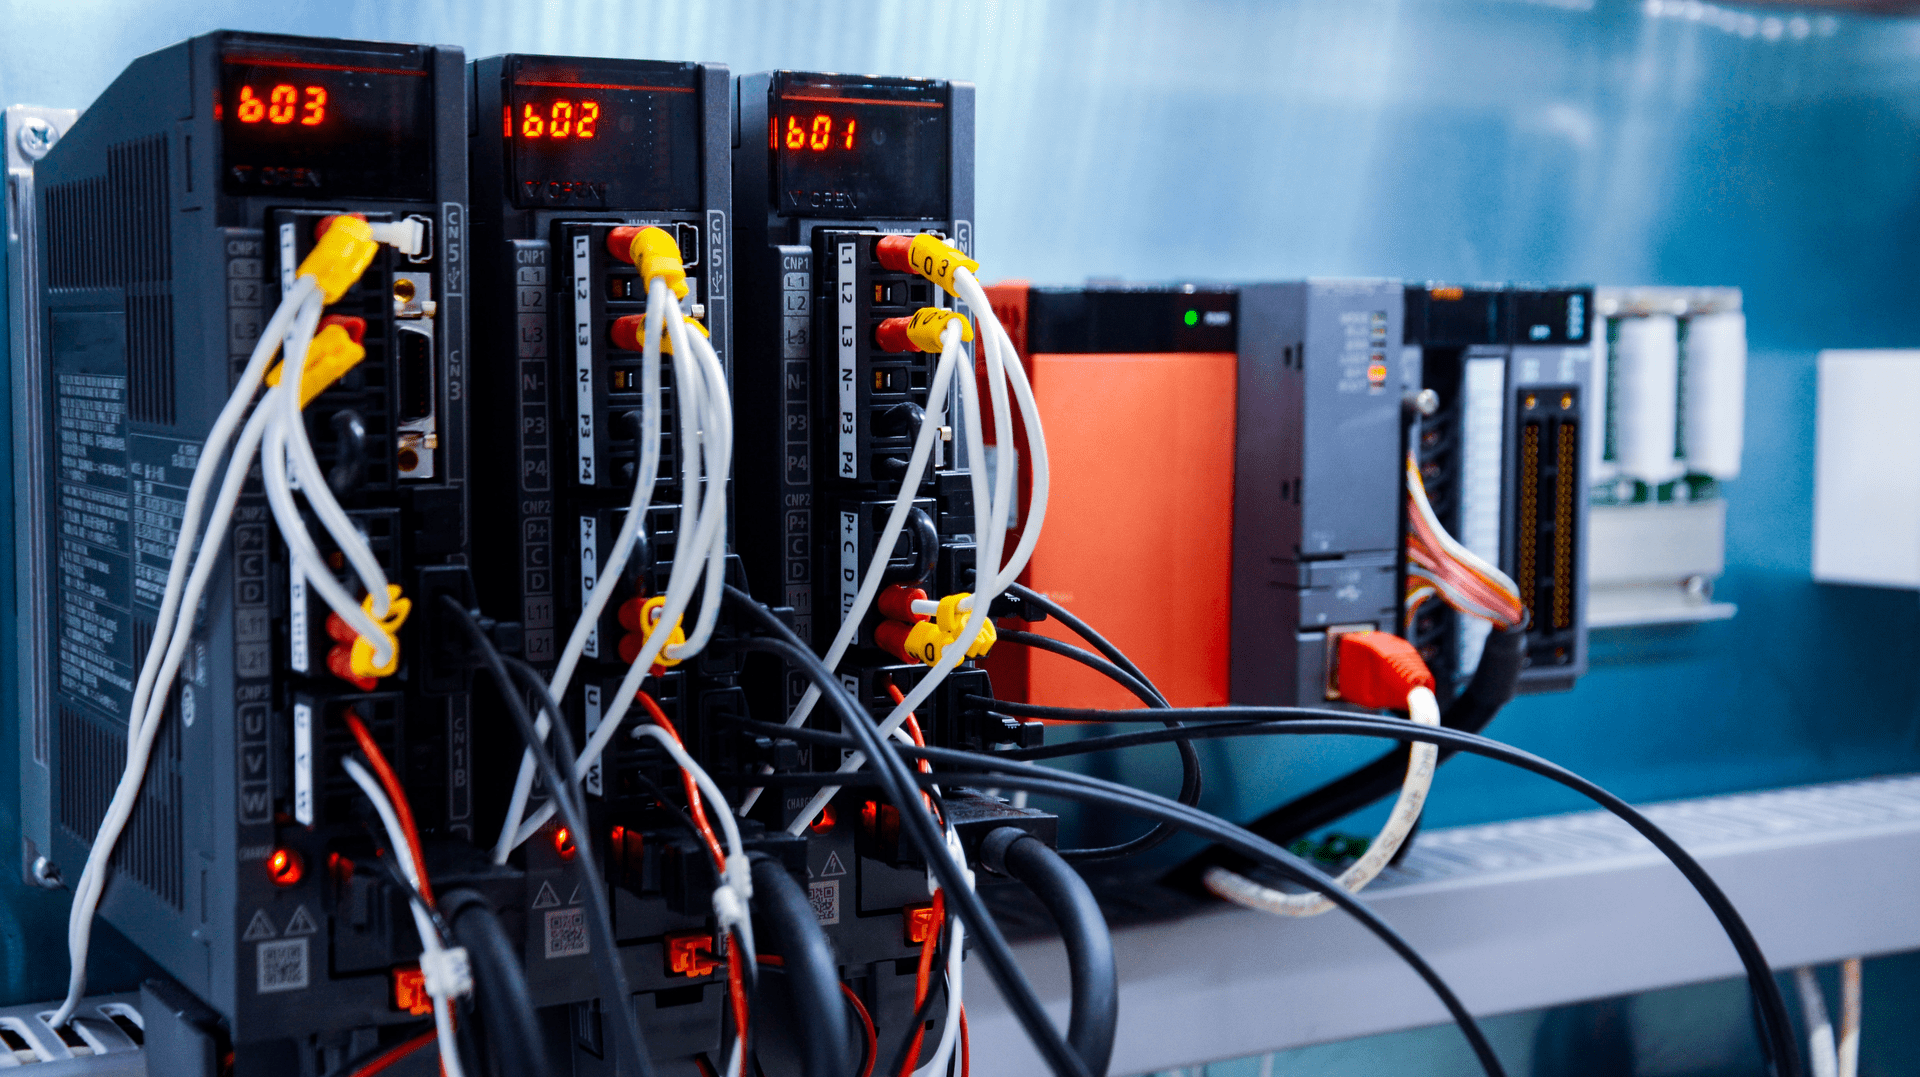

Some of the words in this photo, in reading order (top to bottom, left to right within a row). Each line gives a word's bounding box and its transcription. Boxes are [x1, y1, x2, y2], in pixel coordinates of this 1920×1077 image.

[447, 211, 459, 263] CN5
[711, 219, 722, 268] CN5
[958, 228, 968, 253] CN
[575, 238, 586, 259] L1
[842, 245, 852, 265] L1
[516, 250, 545, 264] CNP1
[783, 256, 810, 270] CNP1
[520, 270, 542, 282] L1
[788, 277, 805, 287] L1
[577, 277, 587, 300] L2
[842, 281, 852, 304] L2
[521, 291, 543, 307] L2
[788, 296, 806, 311] L2
[522, 327, 543, 343] L3
[578, 323, 588, 346] L3
[788, 329, 806, 345] L3
[842, 325, 852, 348] L3
[449, 350, 461, 400] CN3
[524, 417, 545, 434] P3
[580, 413, 591, 439] P3
[788, 415, 807, 431] P3
[842, 411, 853, 435] P3
[524, 460, 547, 477] P4
[581, 456, 592, 481] P4
[788, 455, 808, 471] P4
[842, 452, 853, 475] P4
[522, 500, 550, 514] CNP2
[785, 493, 811, 507] CNP2
[527, 523, 547, 540] P+
[583, 518, 593, 540] P+
[789, 516, 807, 531] P+
[843, 513, 854, 534] P+
[792, 538, 804, 554] C
[844, 541, 854, 554] C
[531, 547, 544, 564] C
[583, 549, 594, 561] C
[793, 562, 805, 578] D
[844, 569, 854, 582] D
[532, 573, 545, 589] D
[584, 576, 594, 591] D
[528, 605, 549, 621] L11
[528, 637, 549, 654] L21
